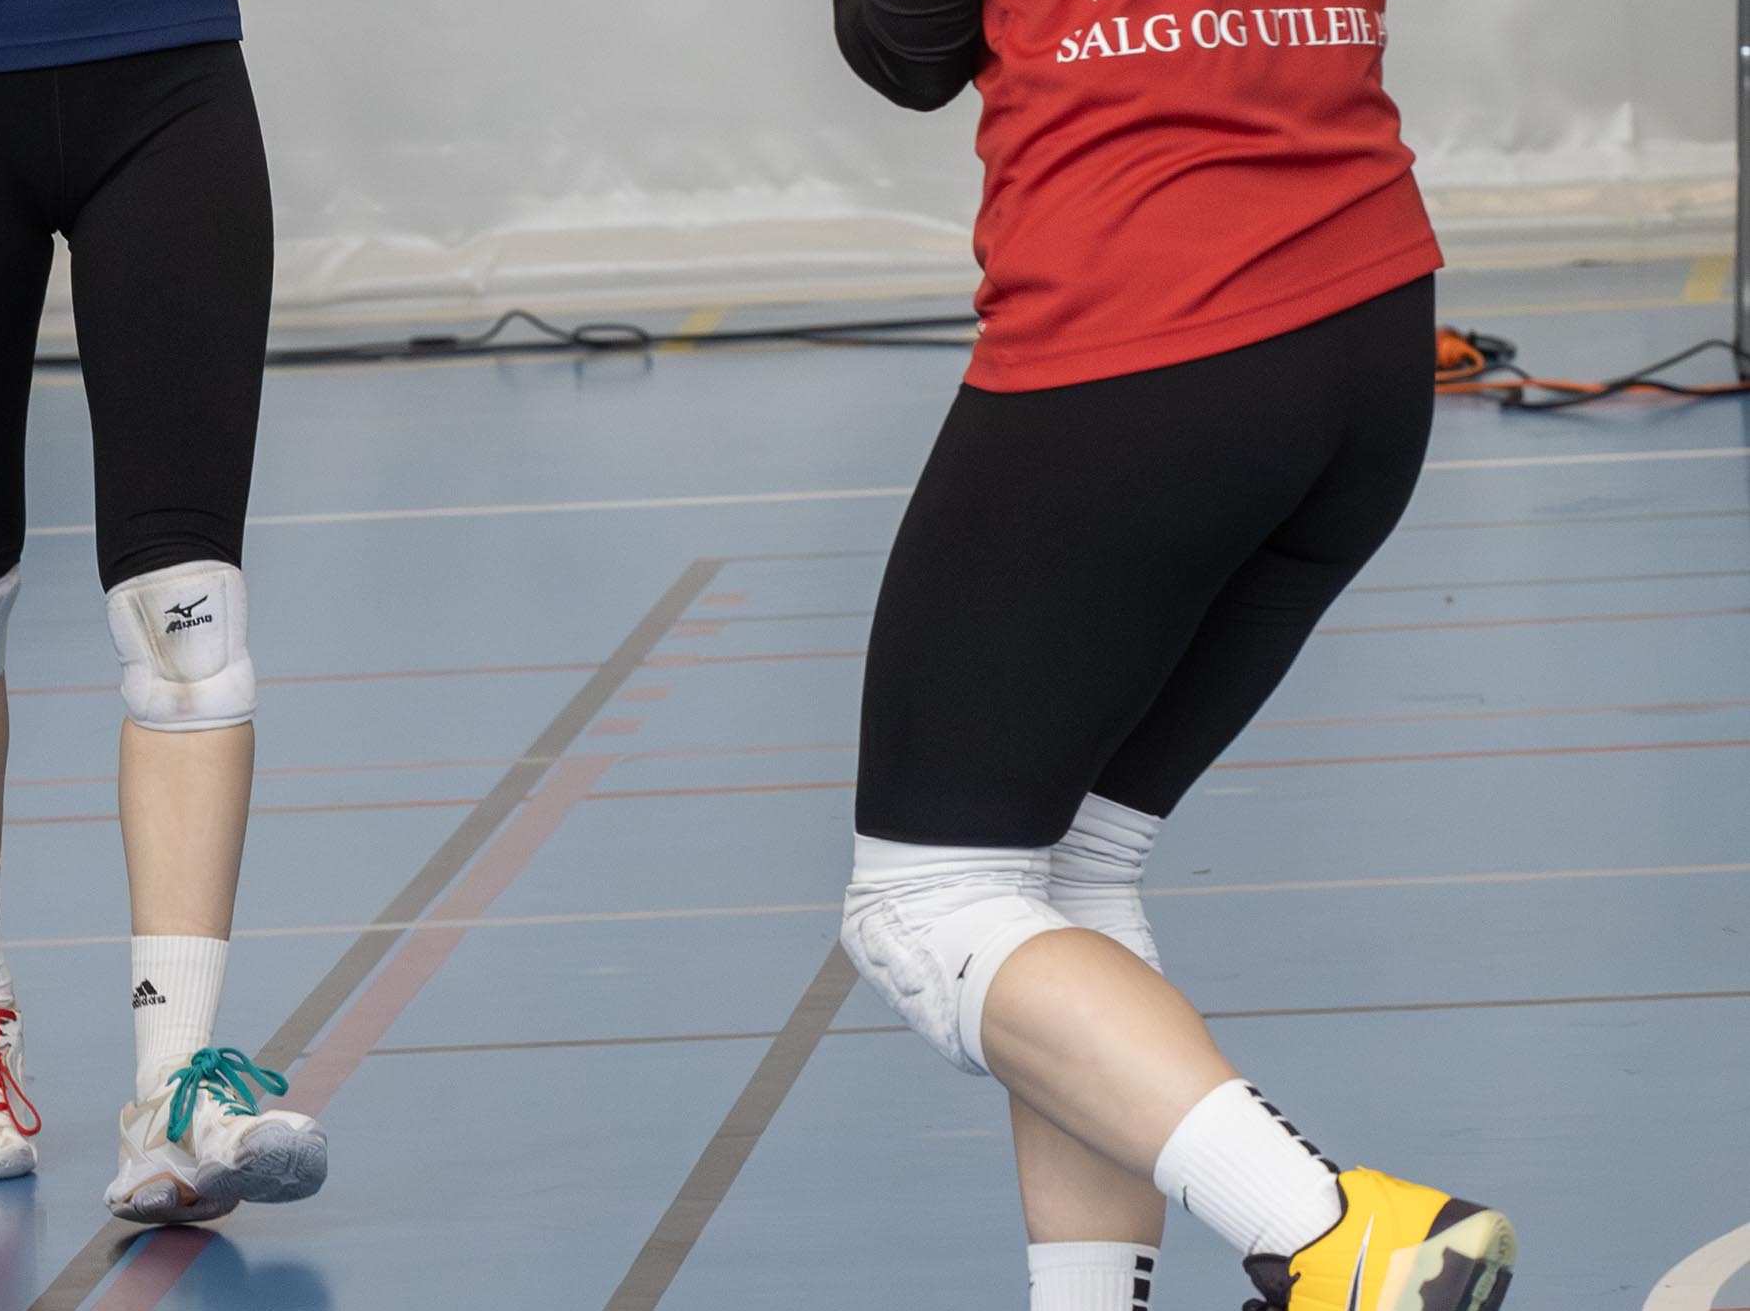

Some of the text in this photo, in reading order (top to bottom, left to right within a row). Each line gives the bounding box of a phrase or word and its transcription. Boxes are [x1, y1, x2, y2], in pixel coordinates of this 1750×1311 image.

[1056, 13, 1182, 63] SALG
[1190, 9, 1248, 49] OG
[1250, 6, 1376, 47] UTLEIE
